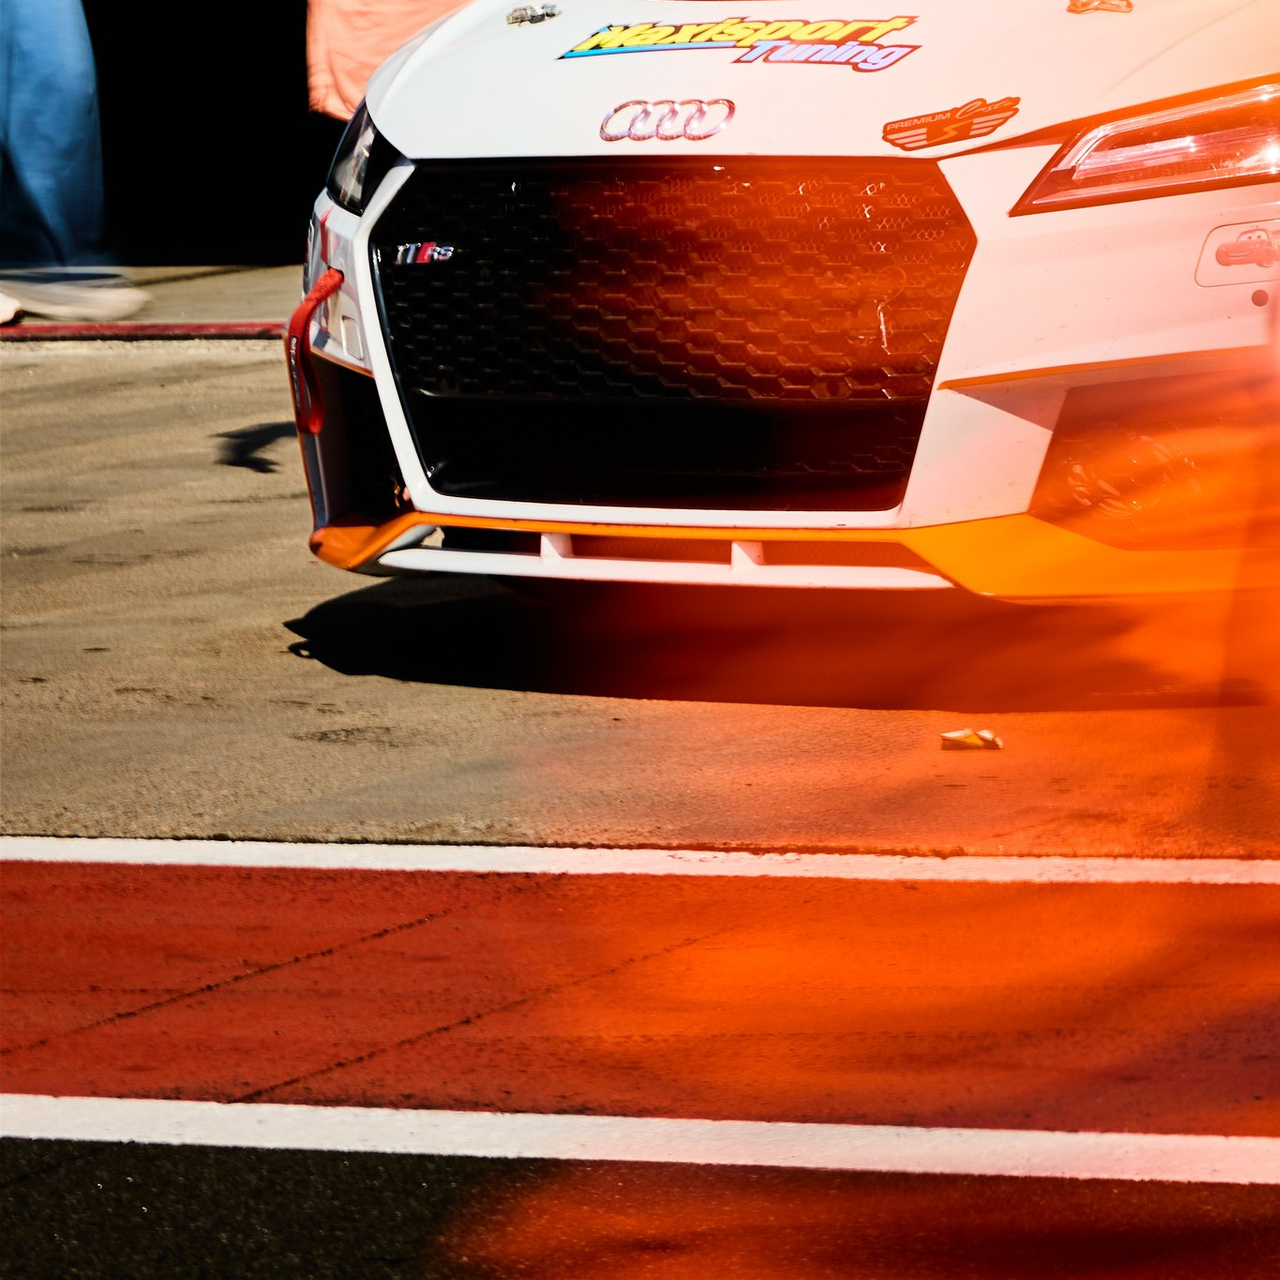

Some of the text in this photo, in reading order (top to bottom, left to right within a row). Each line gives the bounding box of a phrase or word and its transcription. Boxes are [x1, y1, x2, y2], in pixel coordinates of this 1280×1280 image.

[572, 17, 918, 48] Maxisport
[738, 40, 914, 70] Tuning
[886, 112, 952, 131] PREMIUM
